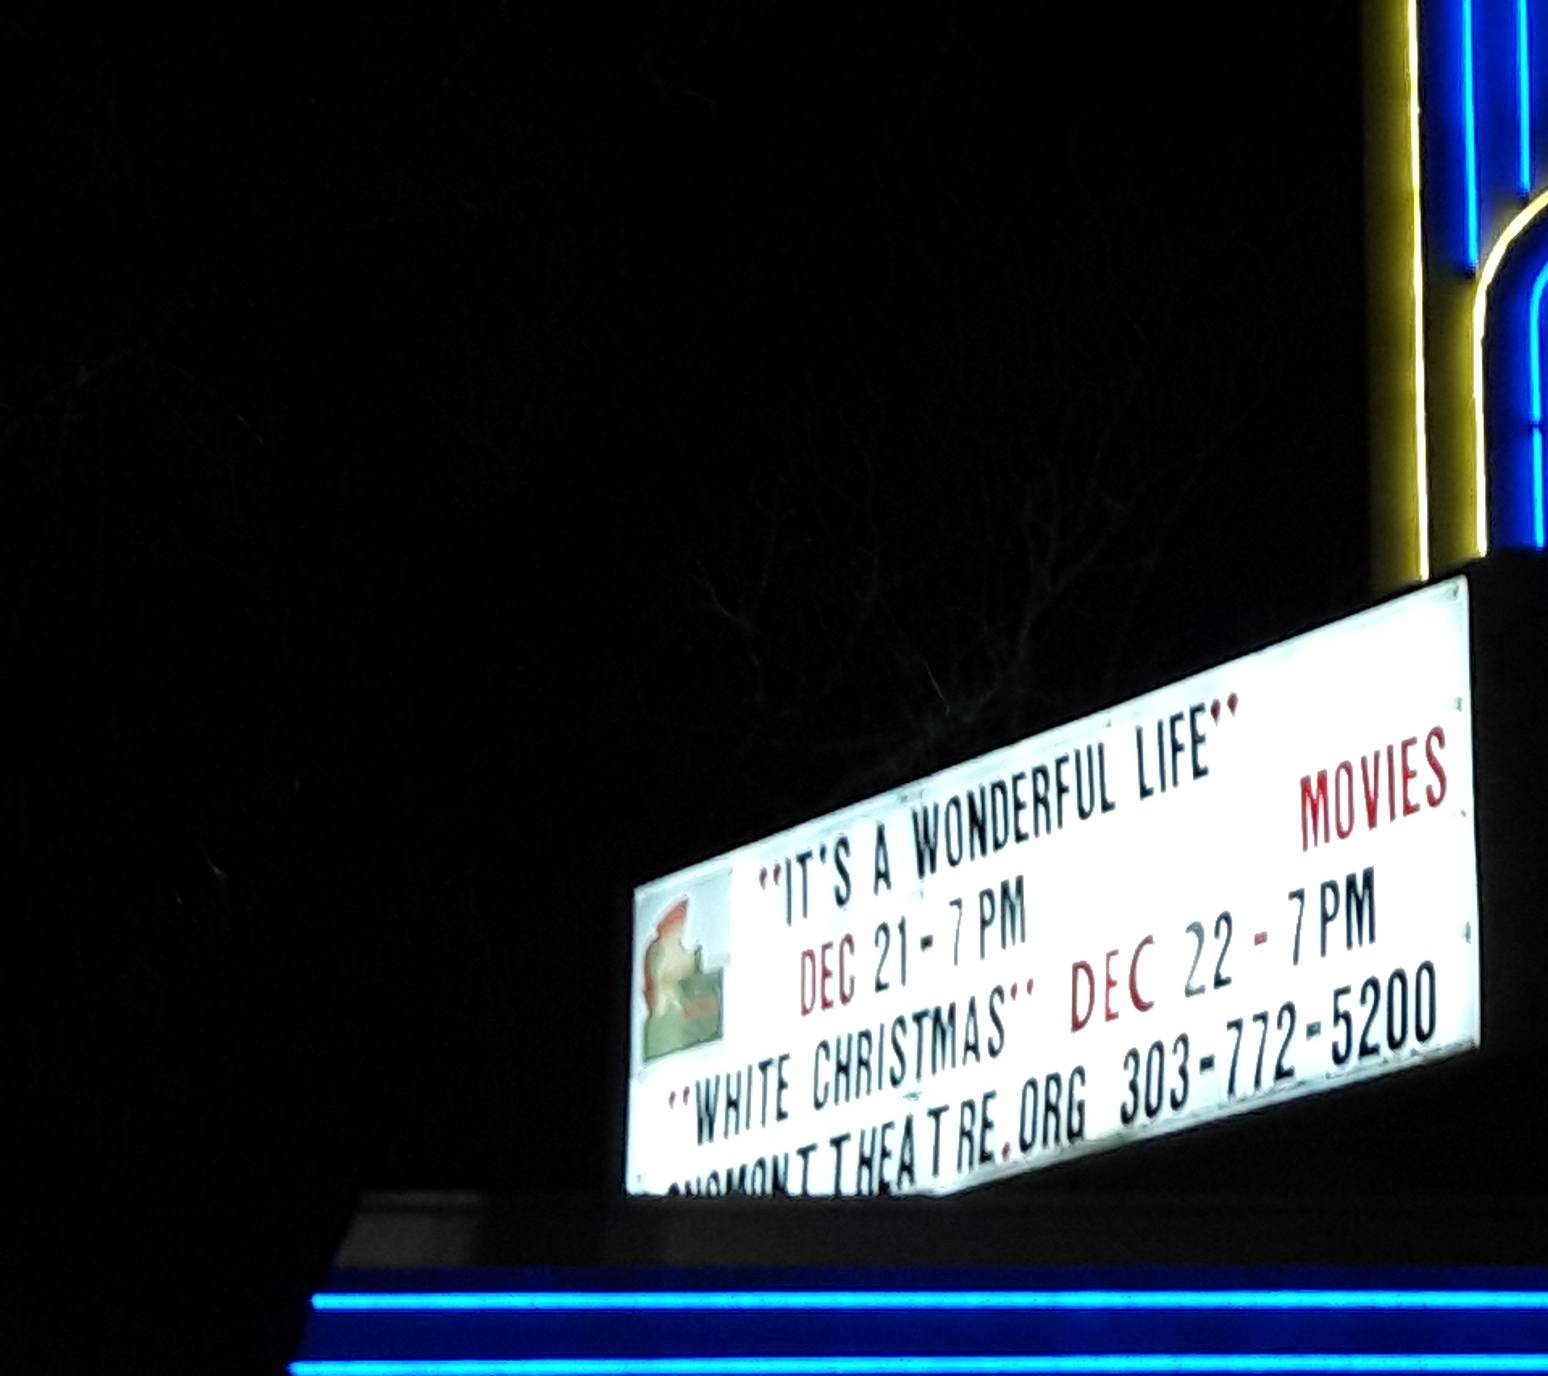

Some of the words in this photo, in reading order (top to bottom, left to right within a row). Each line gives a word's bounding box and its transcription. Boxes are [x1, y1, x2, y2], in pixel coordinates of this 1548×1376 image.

[873, 820, 892, 896] A
[910, 740, 1117, 881] WONDERFUL
[1300, 725, 1448, 852] MOVIES
[800, 932, 856, 1017] DEC
[977, 874, 1027, 961] PM
[1070, 934, 1155, 1034] DEC
[1184, 910, 1234, 999] 22
[1319, 865, 1377, 959] PM
[1119, 959, 1438, 1132] 303-772-5200
